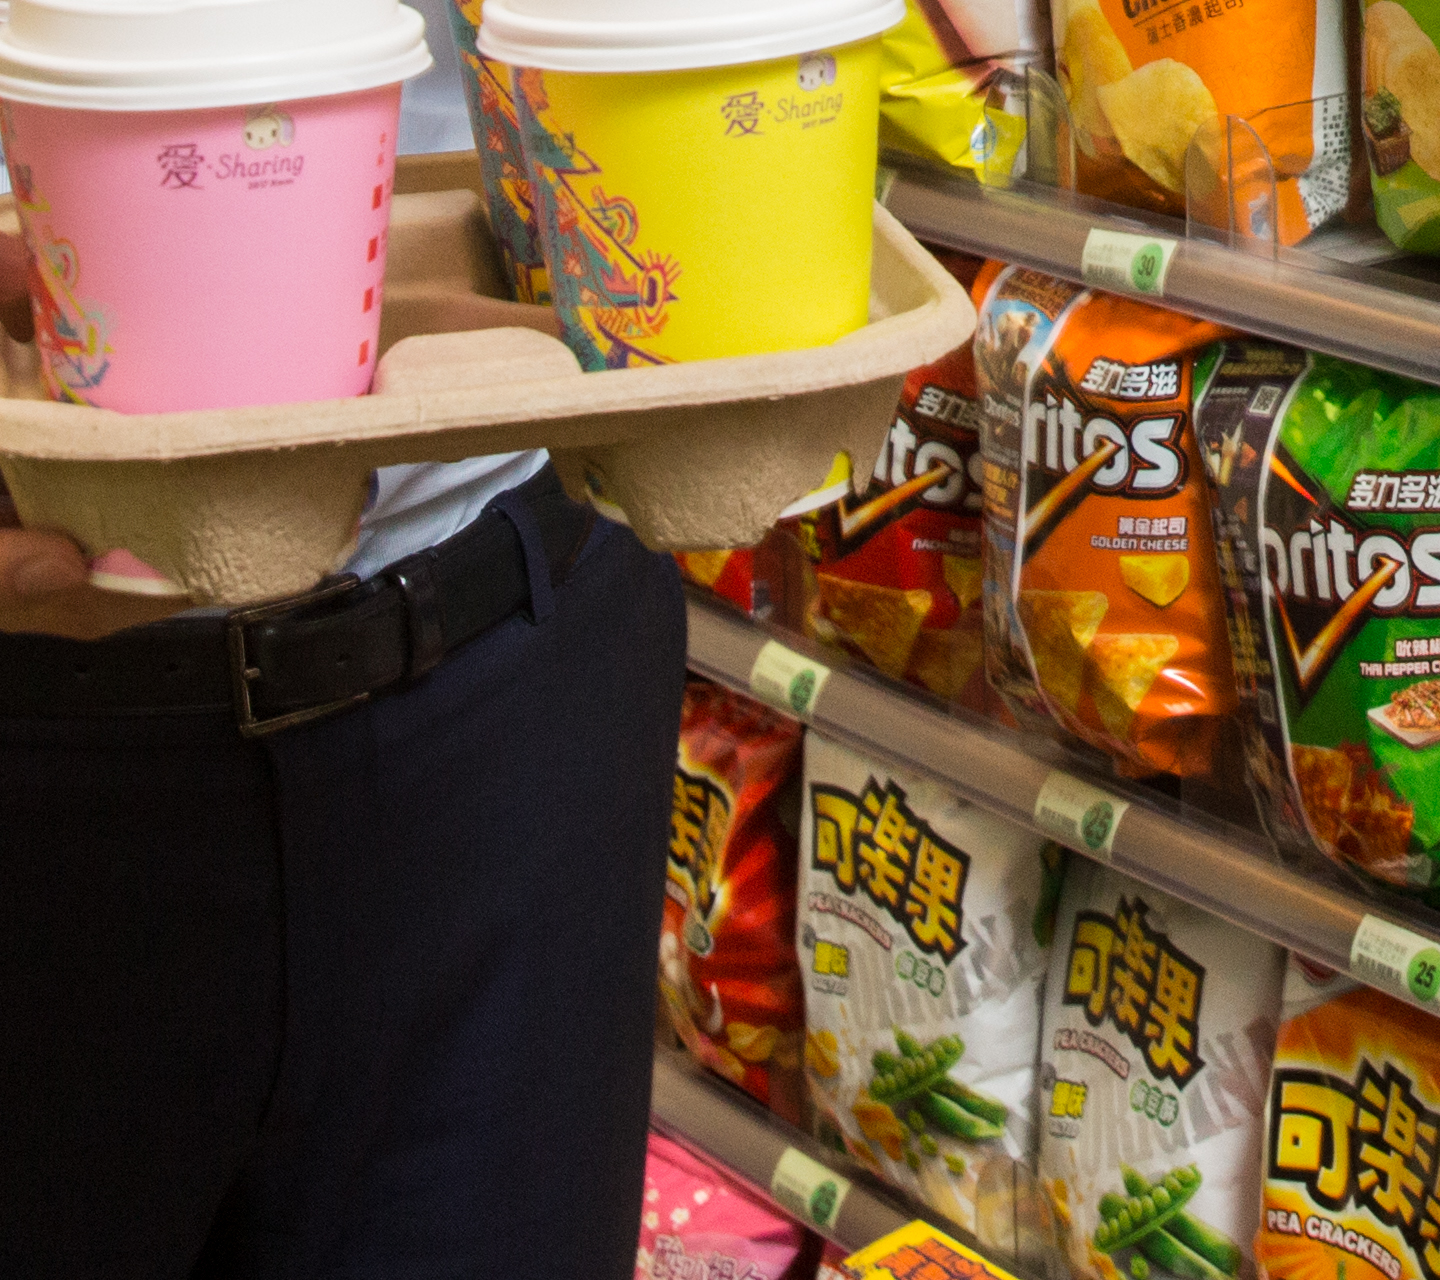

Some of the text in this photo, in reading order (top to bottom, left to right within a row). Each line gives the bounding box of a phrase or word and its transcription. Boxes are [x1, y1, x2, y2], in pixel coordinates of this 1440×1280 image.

[1080, 359, 1179, 398] 多力多滋
[1027, 391, 1180, 491] ritos
[1090, 535, 1189, 551] GOLDEN CHEESE
[1360, 661, 1383, 677] THAI
[1384, 660, 1430, 677] PEPPER
[811, 775, 971, 965] 可樂果
[1064, 894, 1206, 1091] 可樂果
[1413, 960, 1437, 989] 25
[1266, 1208, 1402, 1280] PEA CRACKERS
